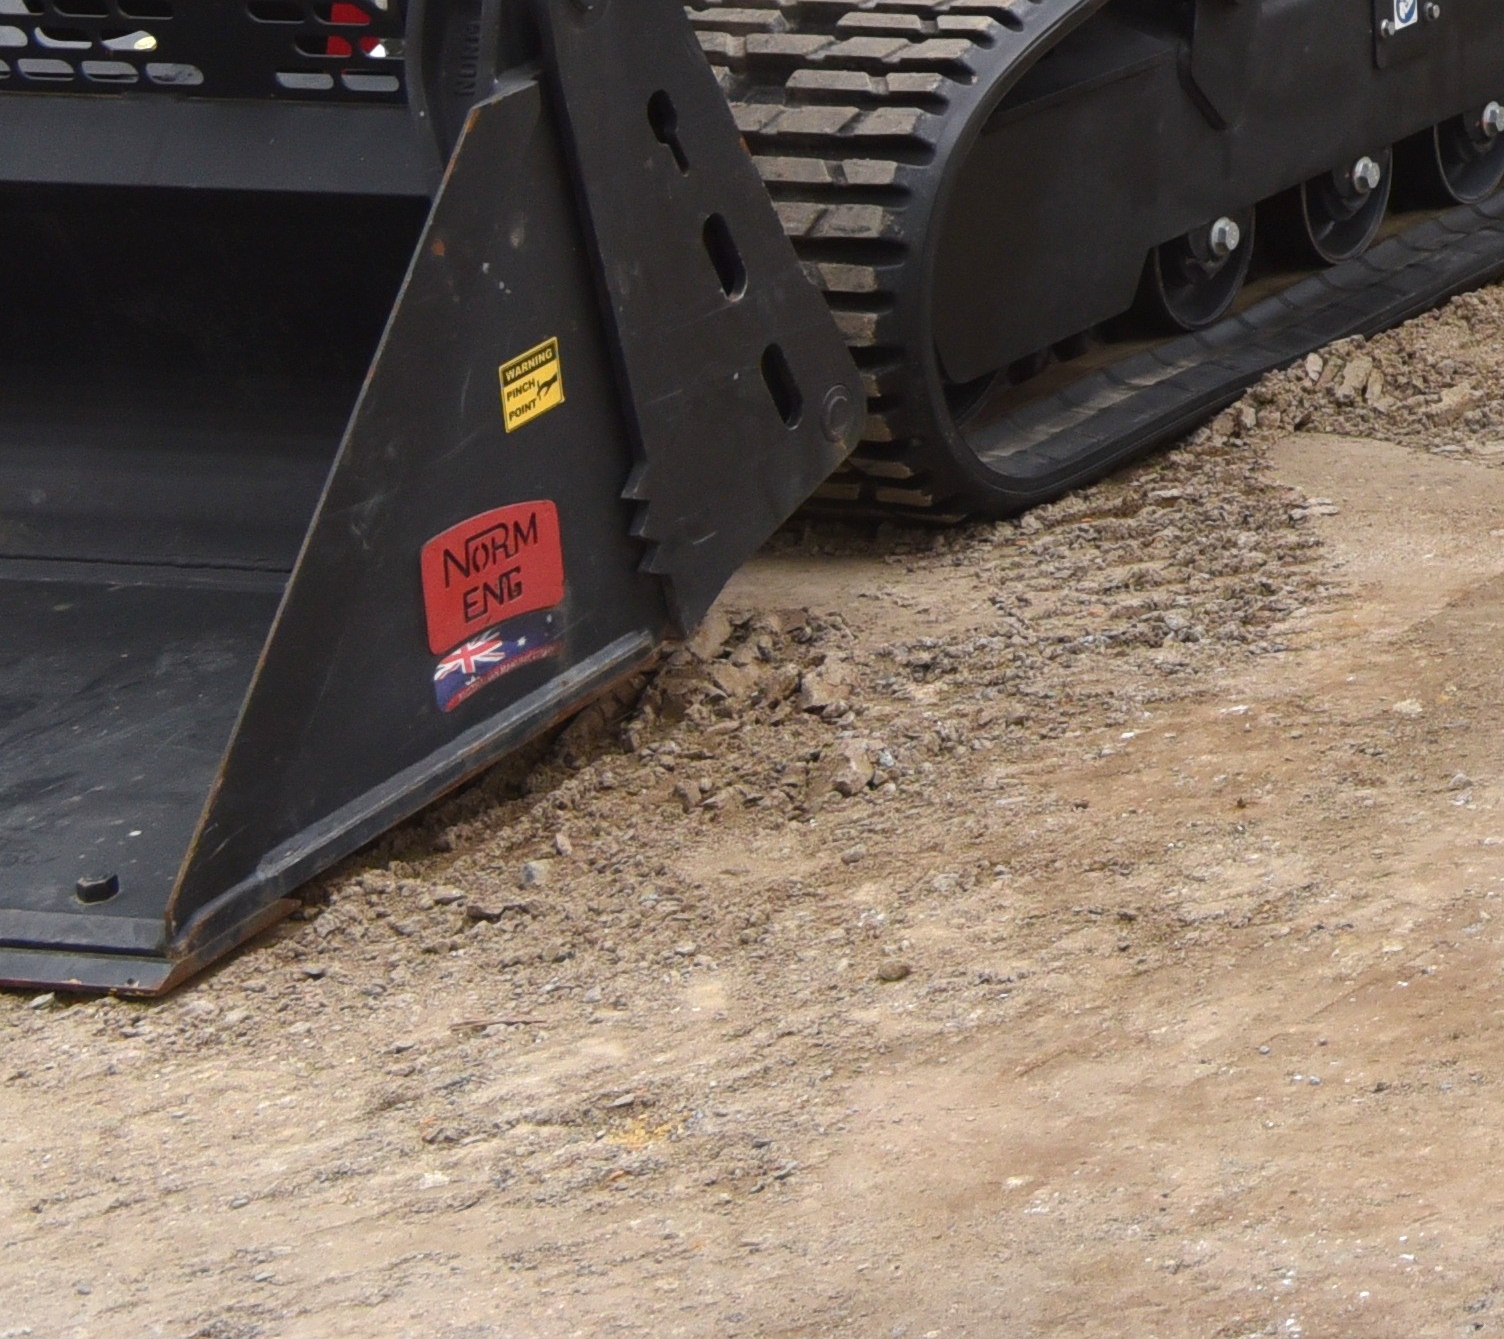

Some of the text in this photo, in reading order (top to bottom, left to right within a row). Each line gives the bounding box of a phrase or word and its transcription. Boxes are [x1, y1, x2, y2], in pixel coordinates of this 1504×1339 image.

[505, 348, 553, 382] WARNING
[505, 377, 536, 403] PINCH
[508, 397, 537, 422] POINT
[443, 512, 539, 590] NORM
[462, 565, 524, 623] ENG
